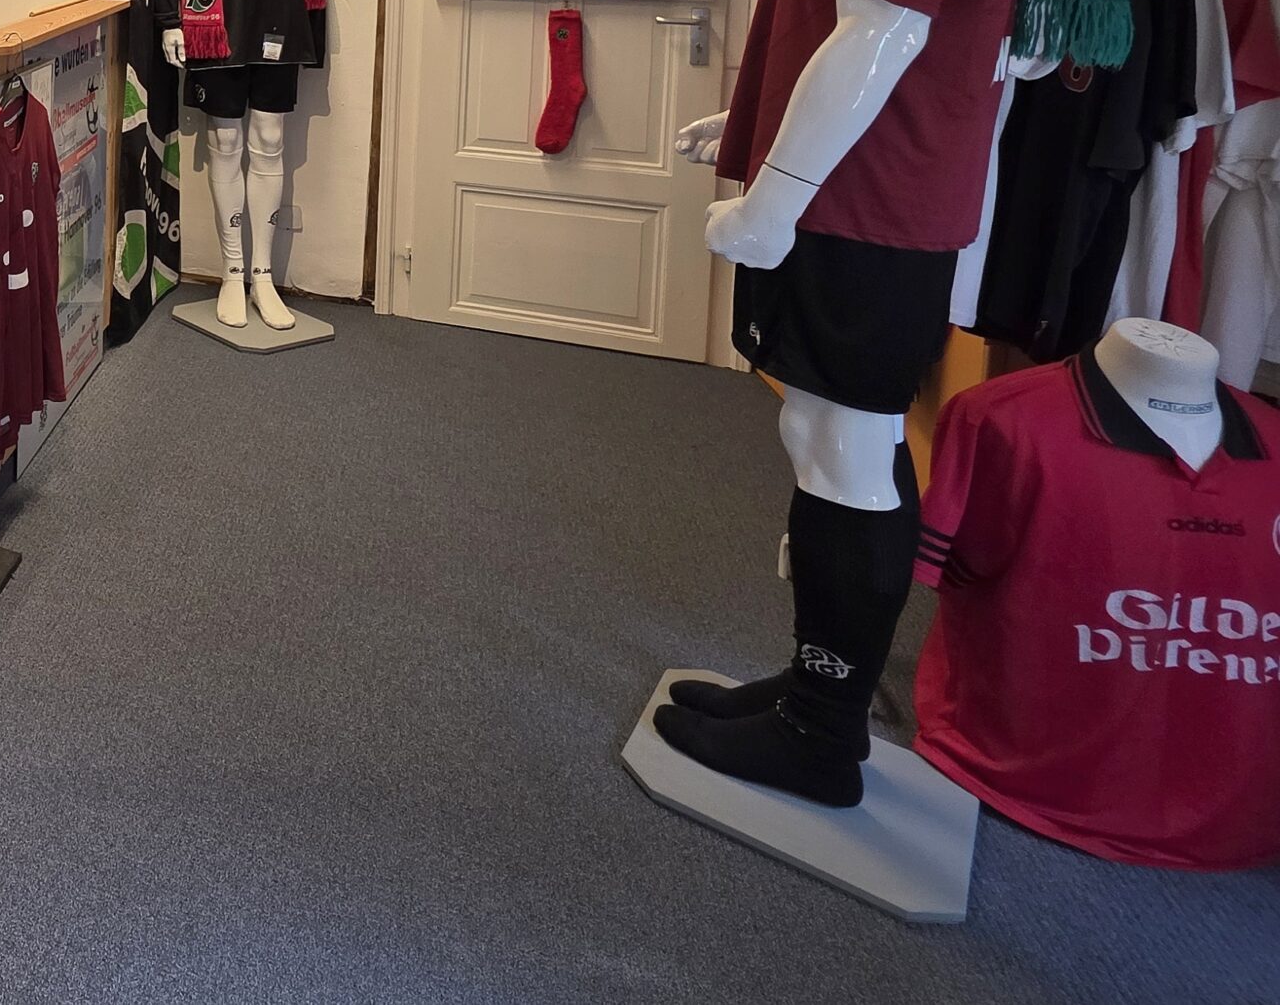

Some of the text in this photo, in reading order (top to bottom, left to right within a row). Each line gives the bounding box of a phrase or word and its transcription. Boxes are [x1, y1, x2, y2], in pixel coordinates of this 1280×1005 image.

[62, 36, 89, 74] wurden
[157, 211, 181, 243] 96
[1167, 517, 1247, 538] adidas
